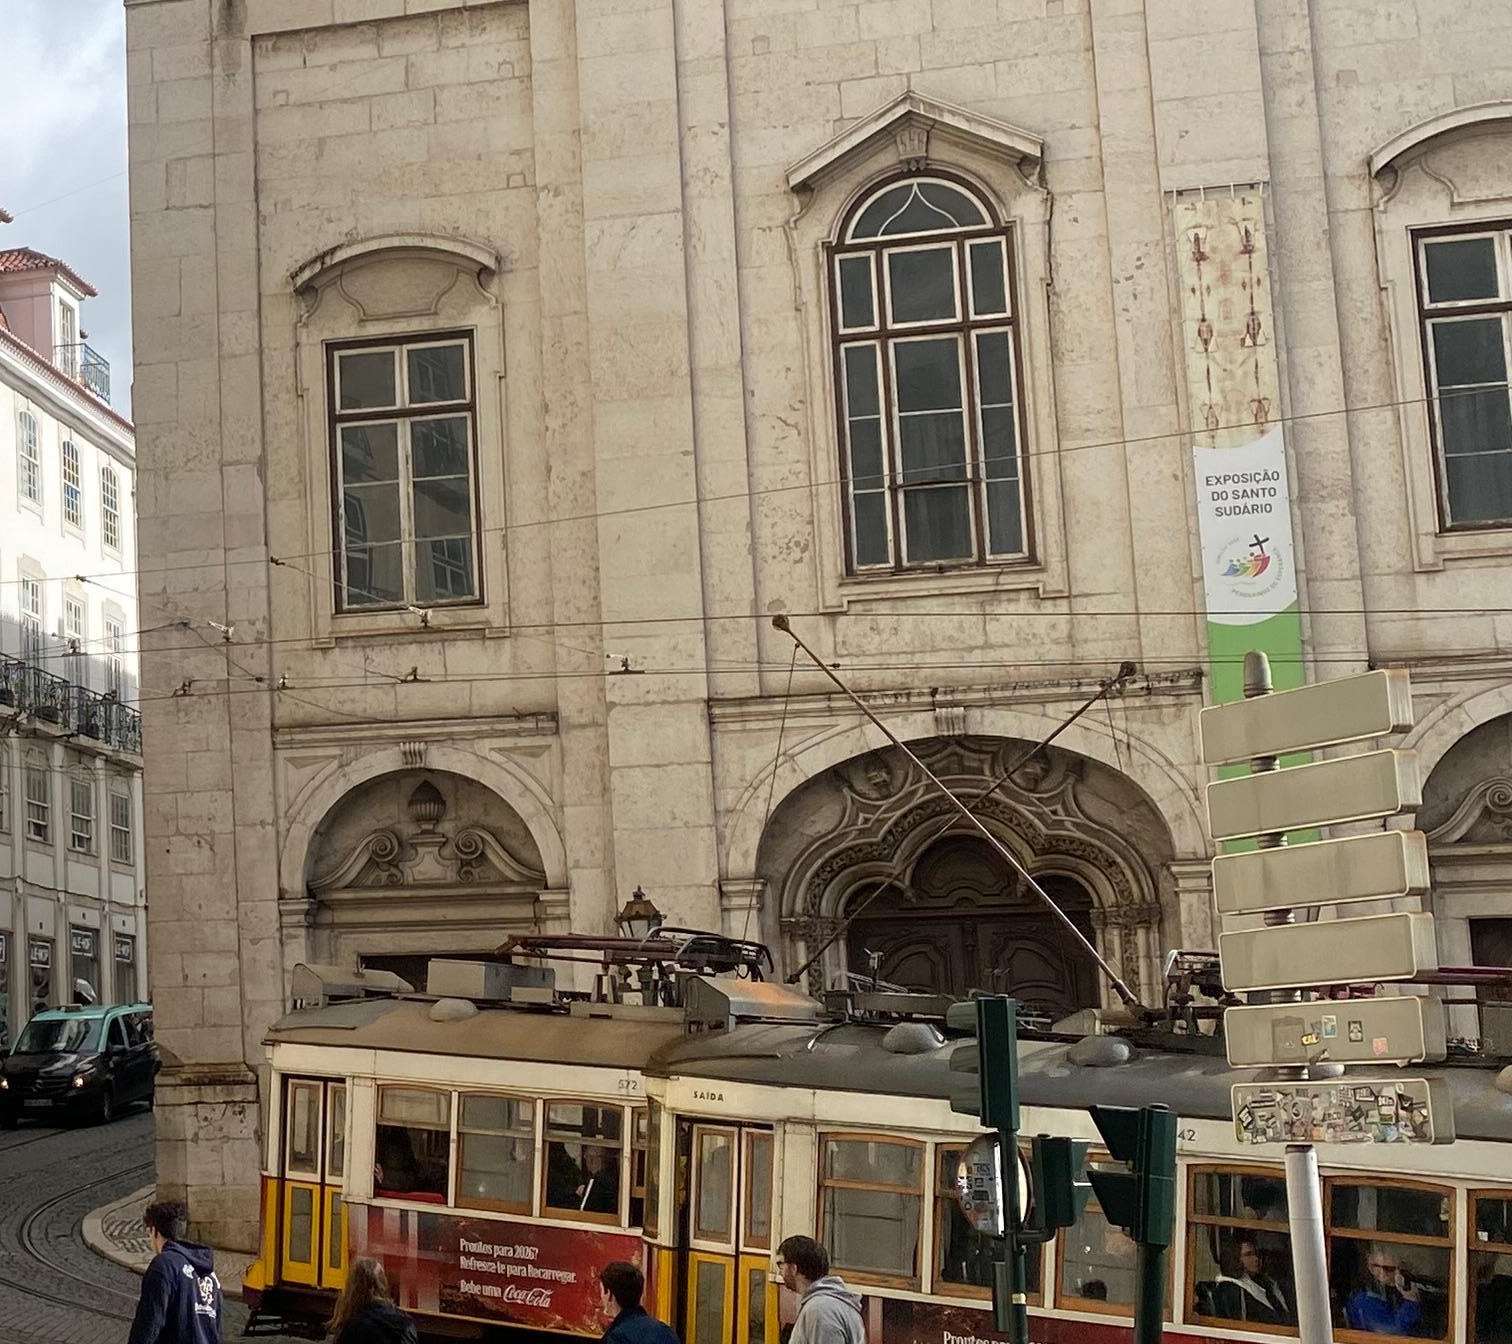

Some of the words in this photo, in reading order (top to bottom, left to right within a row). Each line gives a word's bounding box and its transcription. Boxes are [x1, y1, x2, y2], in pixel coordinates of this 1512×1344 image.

[1205, 469, 1280, 486] EXPOSIÇÃO
[1211, 490, 1228, 502] DO
[1232, 487, 1277, 500] SANTO
[1215, 503, 1273, 517] SUDÁRIO
[459, 1238, 493, 1255] Prontos
[493, 1244, 514, 1258] para
[514, 1244, 539, 1260] 2026?
[506, 1264, 527, 1277] para
[460, 1279, 482, 1295] Bebe
[482, 1285, 502, 1298] uma
